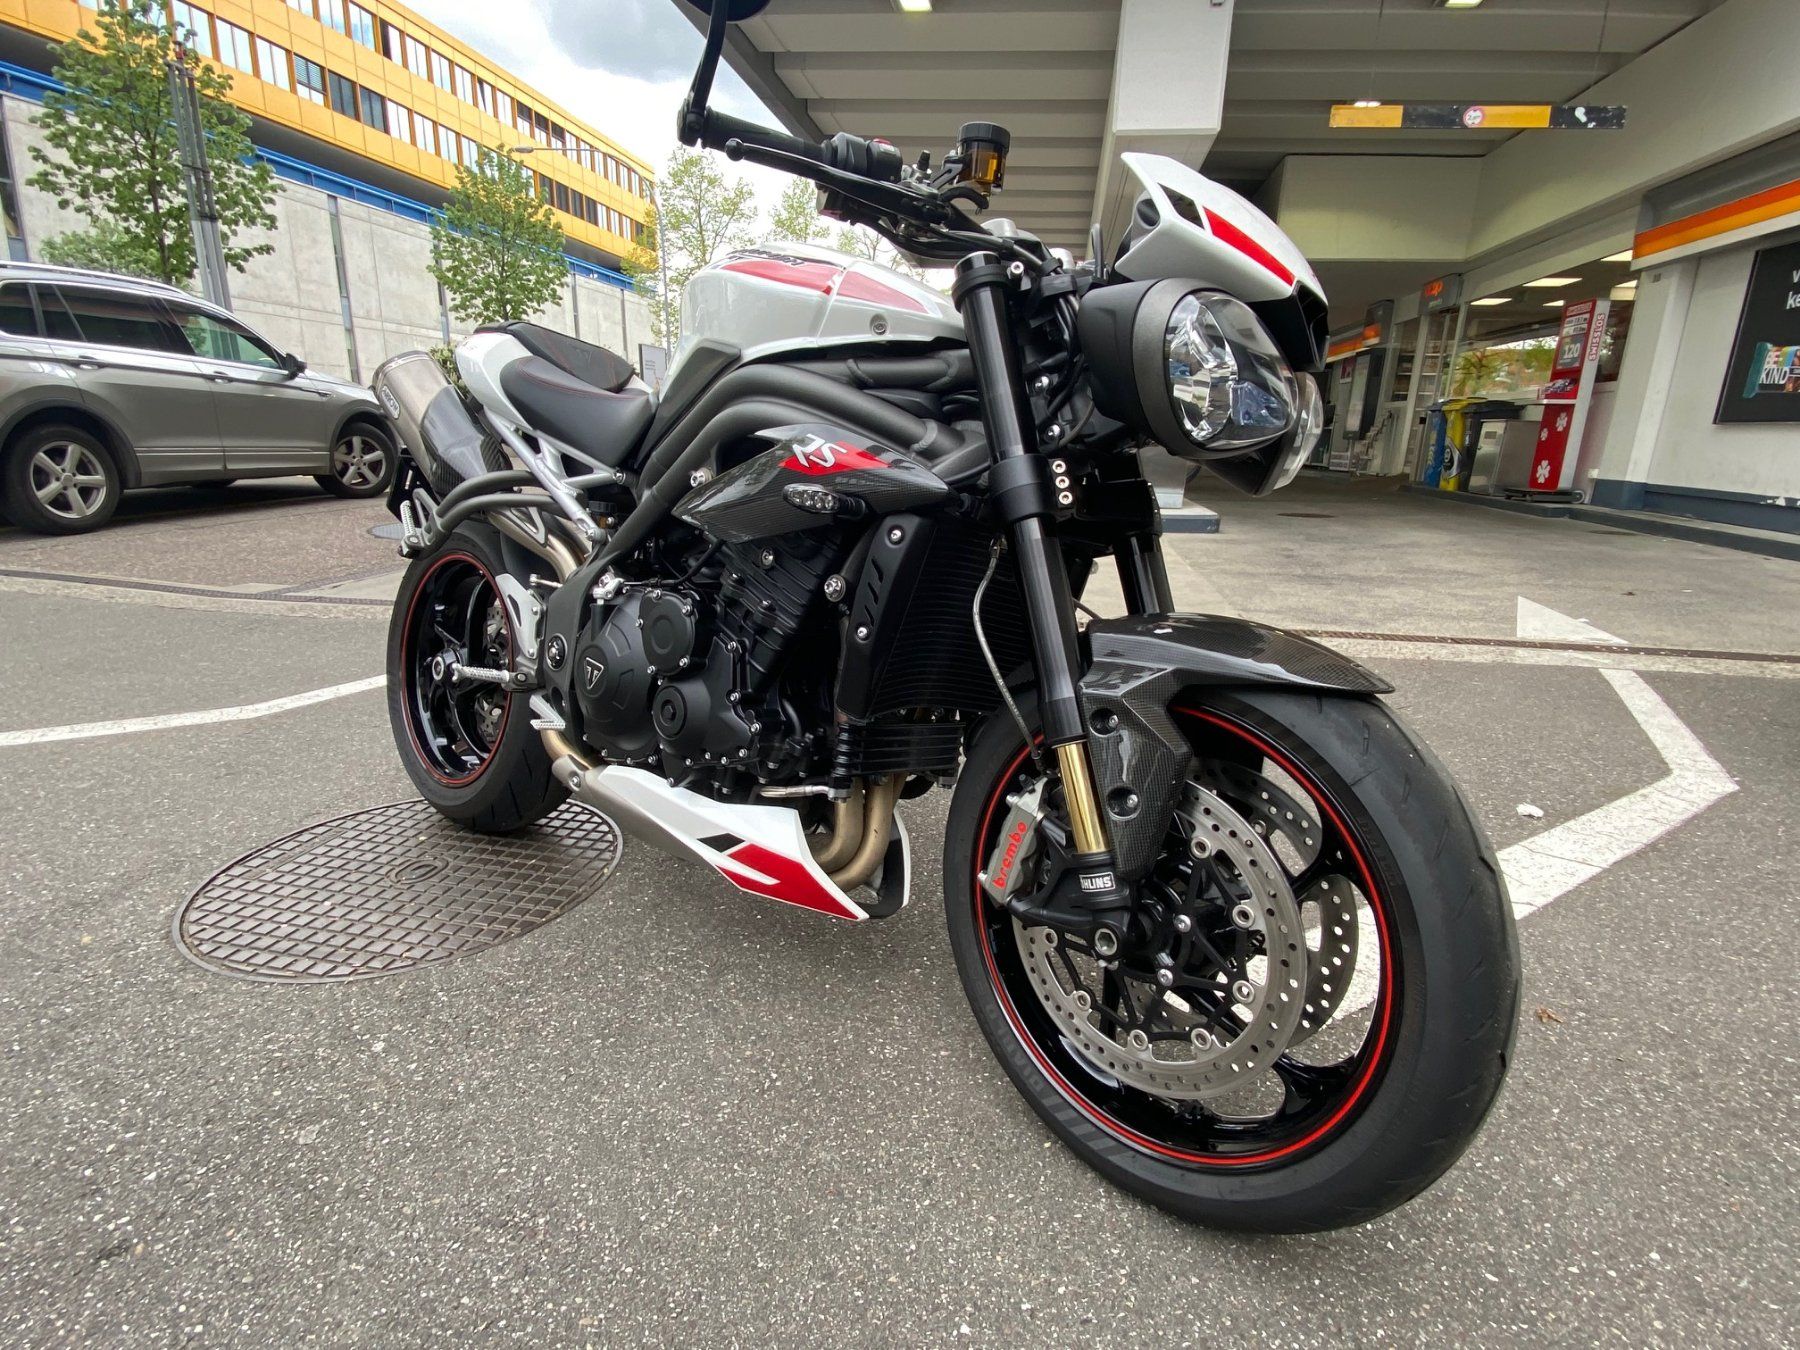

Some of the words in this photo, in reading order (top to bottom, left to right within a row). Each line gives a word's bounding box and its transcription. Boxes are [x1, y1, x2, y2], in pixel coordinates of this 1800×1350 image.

[1563, 343, 1580, 359] 120
[1589, 314, 1605, 361] SWISSLOS
[1759, 367, 1790, 384] KIND
[792, 433, 848, 468] RS
[992, 821, 1027, 889] brembo
